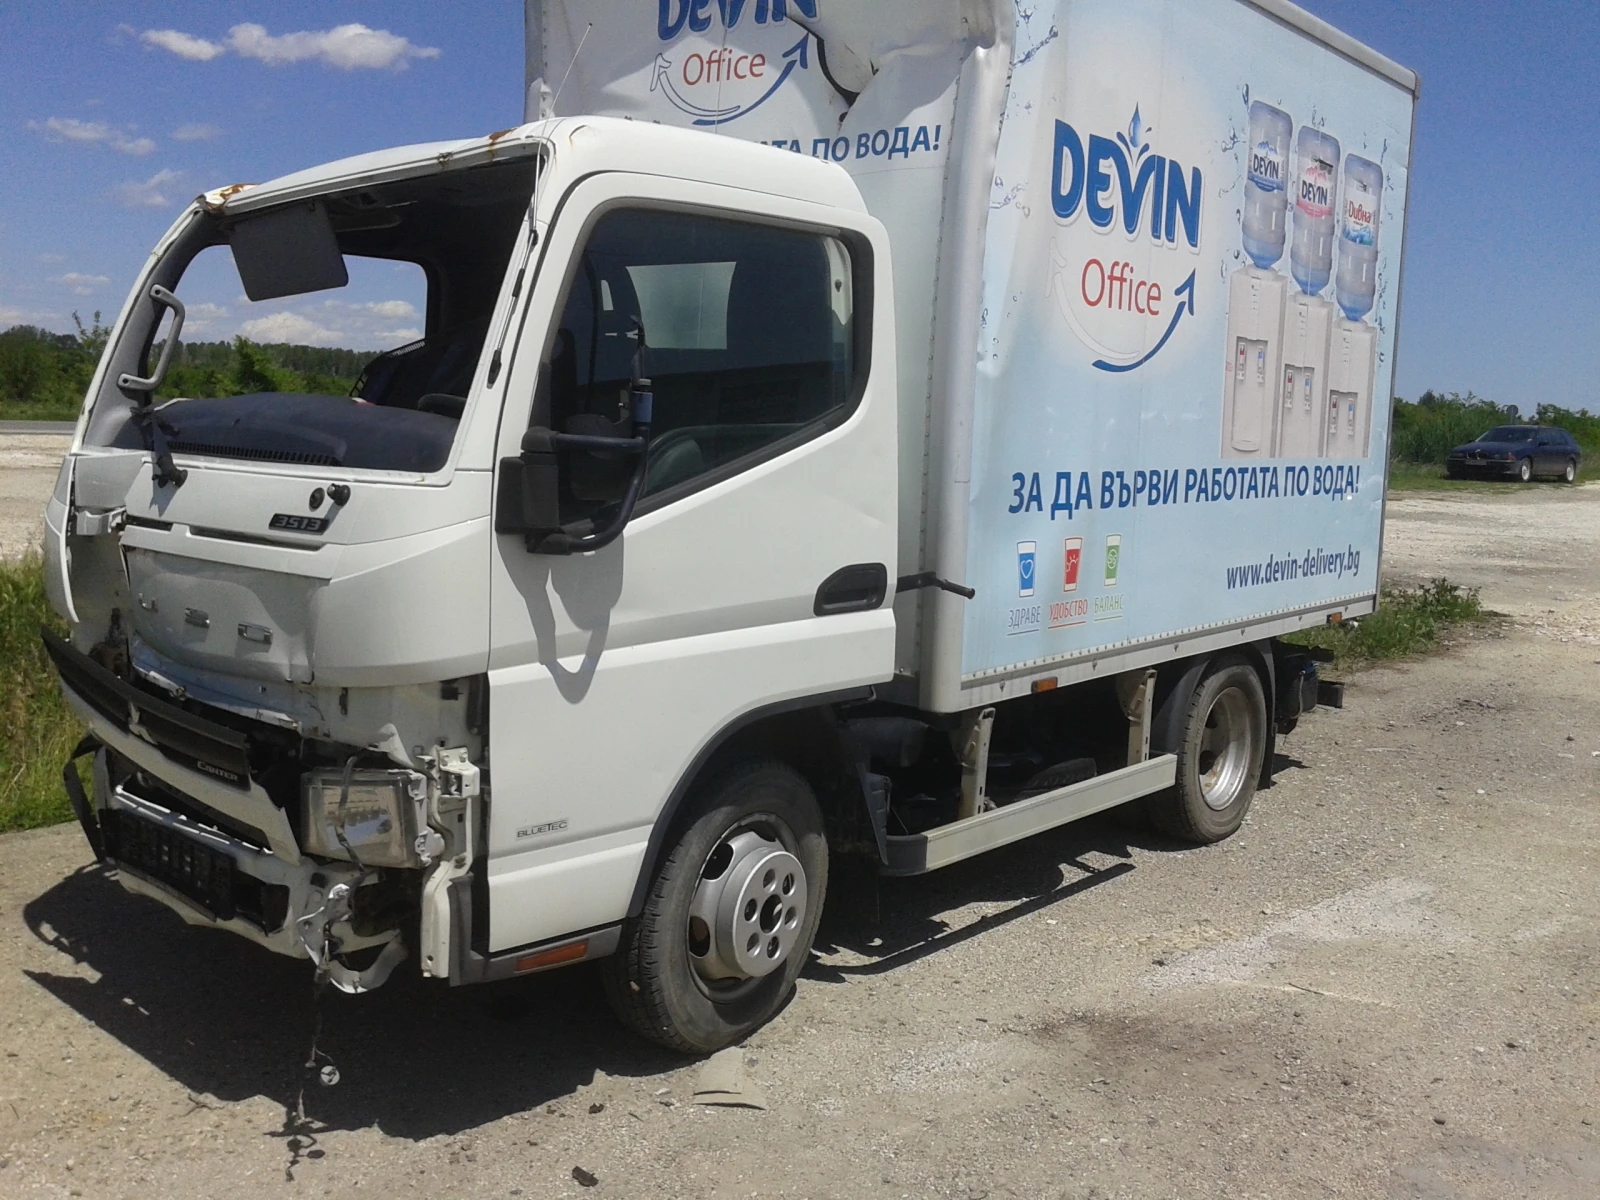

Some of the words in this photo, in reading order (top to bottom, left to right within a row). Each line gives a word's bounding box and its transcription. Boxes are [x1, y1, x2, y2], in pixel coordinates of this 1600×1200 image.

[683, 47, 766, 86] Office
[812, 136, 850, 162] ПО
[856, 124, 941, 160] ВОДА!
[1051, 118, 1202, 248] DEVIN
[1253, 153, 1280, 180] DEVIN
[1301, 179, 1328, 206] DEVIN
[1081, 258, 1162, 316] Office
[1008, 471, 1043, 514] ЗА
[1051, 471, 1093, 521] ДА
[1100, 469, 1179, 509] ВЪРВИ
[1184, 466, 1279, 503] РАБОТАТА
[1284, 465, 1309, 497] ПО
[1313, 465, 1360, 502] ВОДА!
[275, 515, 321, 531] 3513
[1227, 543, 1361, 590] www.devin-delivery.bg
[1008, 605, 1041, 629] ЗДРАВЕ
[1048, 599, 1089, 622] УДОБСТВО
[1094, 594, 1124, 614] БАЛАНС
